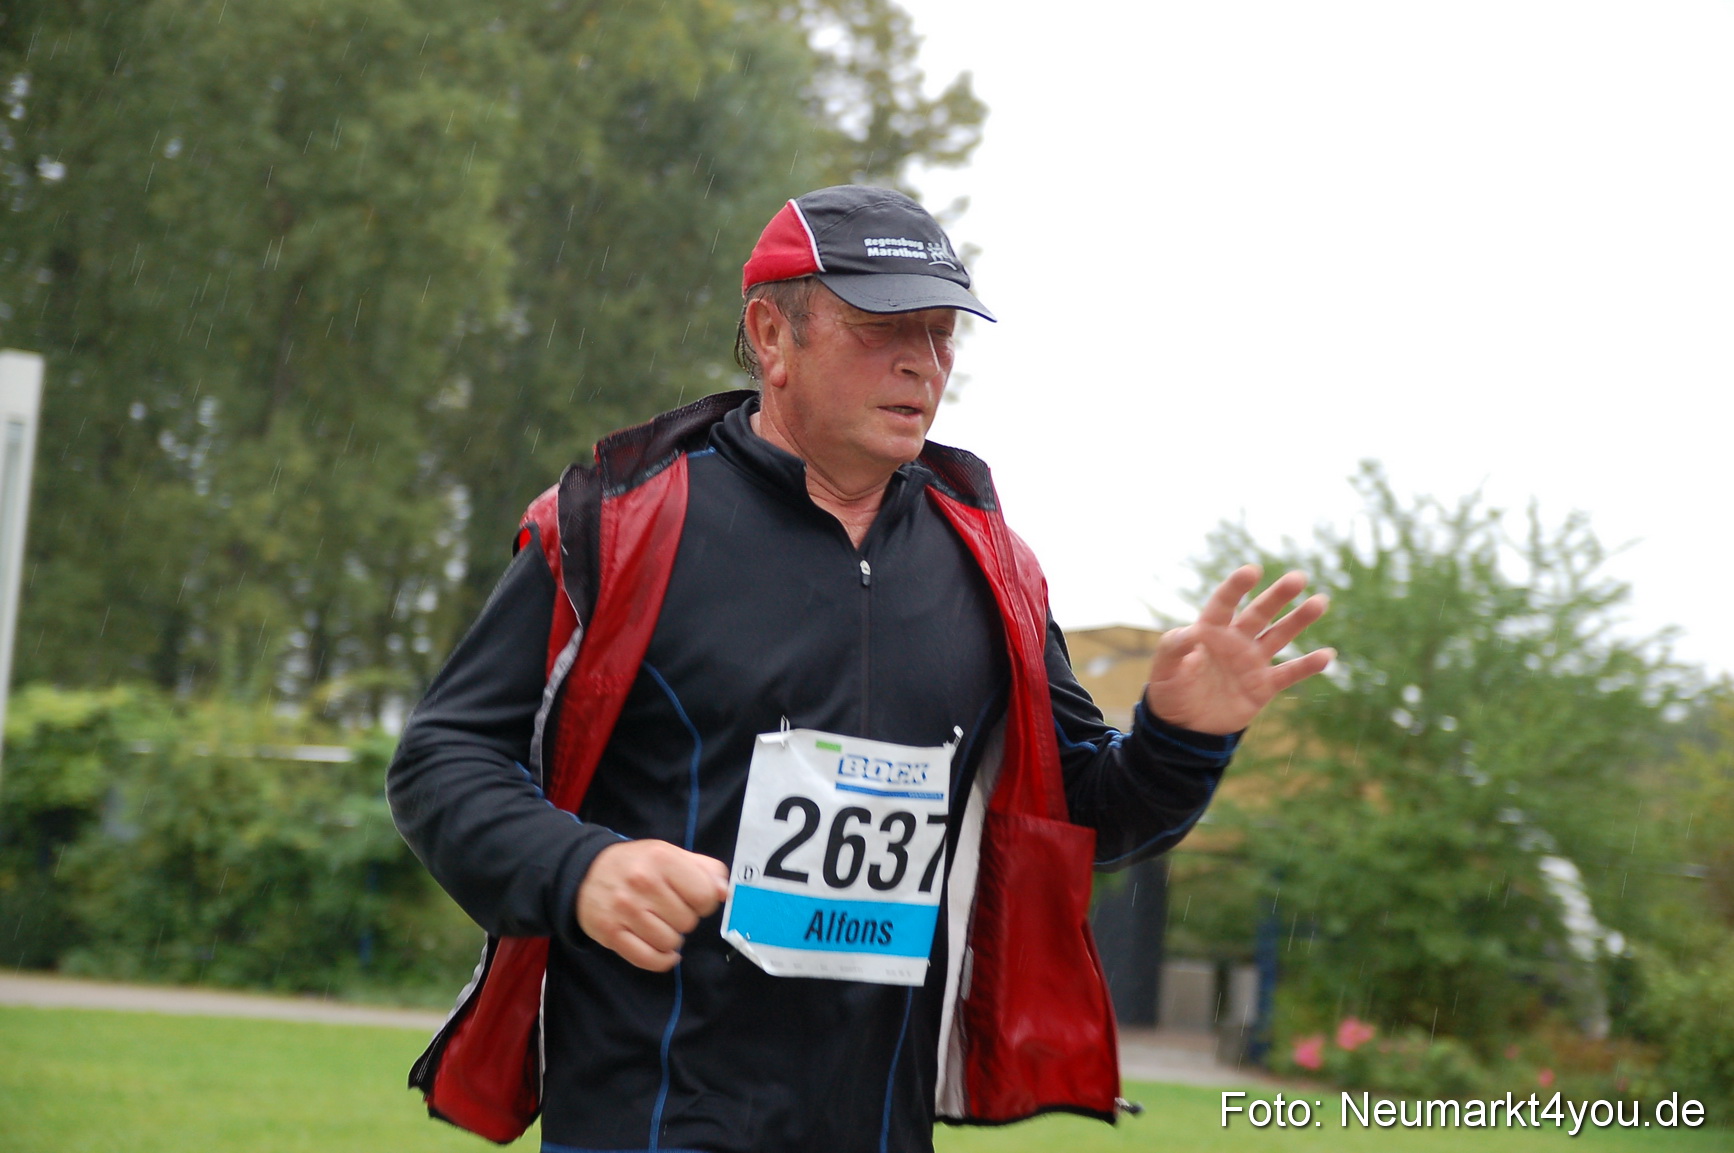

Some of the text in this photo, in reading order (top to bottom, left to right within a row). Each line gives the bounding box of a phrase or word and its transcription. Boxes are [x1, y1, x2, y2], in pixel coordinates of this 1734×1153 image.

[867, 247, 928, 259] Marathon
[838, 753, 929, 785] BOCK
[763, 796, 949, 893] 2637
[803, 908, 894, 946] Alfons
